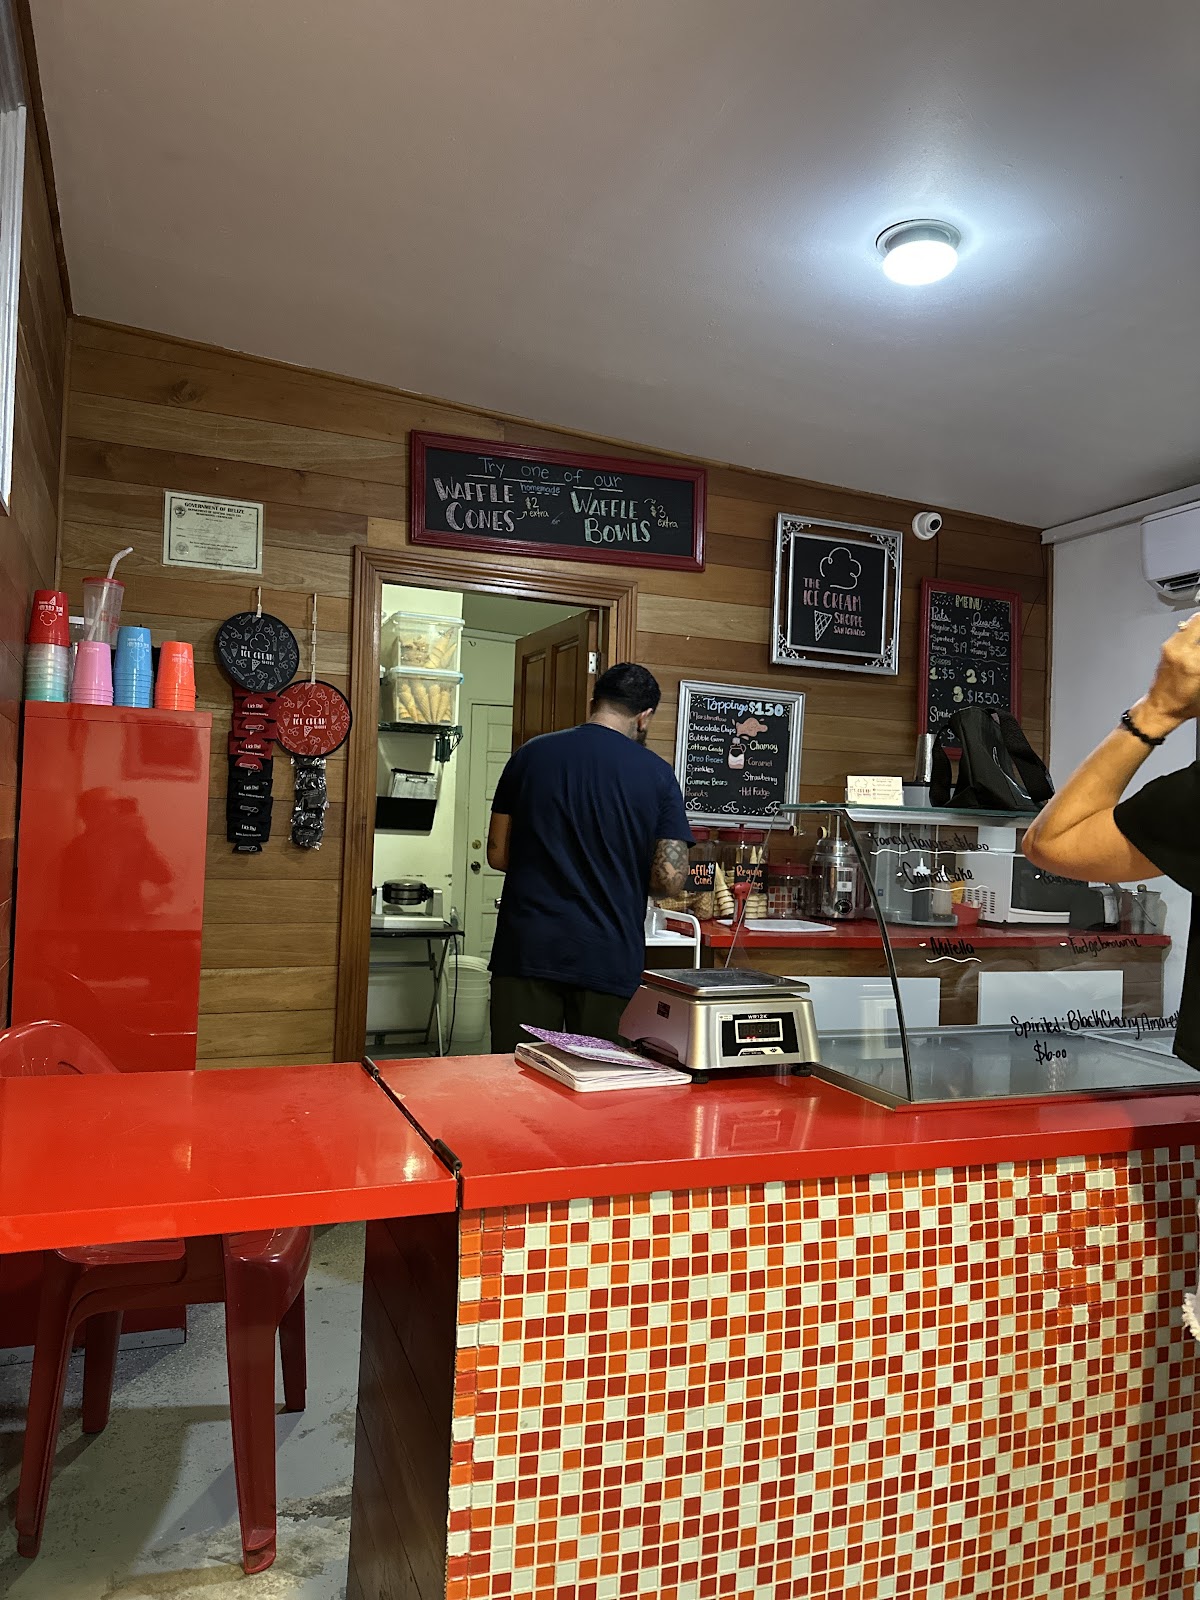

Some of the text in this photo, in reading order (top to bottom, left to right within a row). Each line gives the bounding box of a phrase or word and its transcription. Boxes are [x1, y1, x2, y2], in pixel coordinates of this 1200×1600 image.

[479, 457, 622, 488] Try one of our
[433, 477, 515, 503] WAFFLE
[520, 482, 560, 494] homemade
[185, 502, 217, 511] GOVERNMENT
[525, 496, 539, 509] $2
[570, 491, 638, 520] WAFFLE
[446, 502, 515, 532] CONES
[529, 509, 549, 518] extra
[650, 504, 666, 518] $3
[657, 516, 678, 529] extra
[584, 517, 651, 544] BOWLS
[803, 577, 821, 589] THE
[803, 590, 862, 612] ICE CREAM
[955, 595, 982, 611] MENU
[834, 612, 863, 628] SHOPPE
[952, 624, 967, 635] $15
[994, 630, 1010, 642] $25
[954, 641, 968, 654] $19
[989, 646, 1007, 657] $32
[942, 667, 956, 680] $5
[981, 670, 995, 686] $9
[703, 697, 748, 717] Toppings
[688, 722, 736, 735] Chocolate Chips
[689, 732, 725, 743] Bubble Gum
[687, 742, 723, 755] Cotton Candy
[749, 740, 778, 754] Chamoy
[688, 753, 723, 764] Oreo Pieces
[748, 757, 773, 767] Caramel
[711, 777, 728, 786] Bears
[744, 771, 778, 785] Strawberry
[741, 787, 770, 799] Hot Fudge
[872, 833, 909, 850] Fancy
[736, 865, 763, 877] Regular
[902, 861, 974, 884] Carrot Cake
[930, 936, 975, 955] Nutella
[1068, 935, 1141, 957] Fudge brownie
